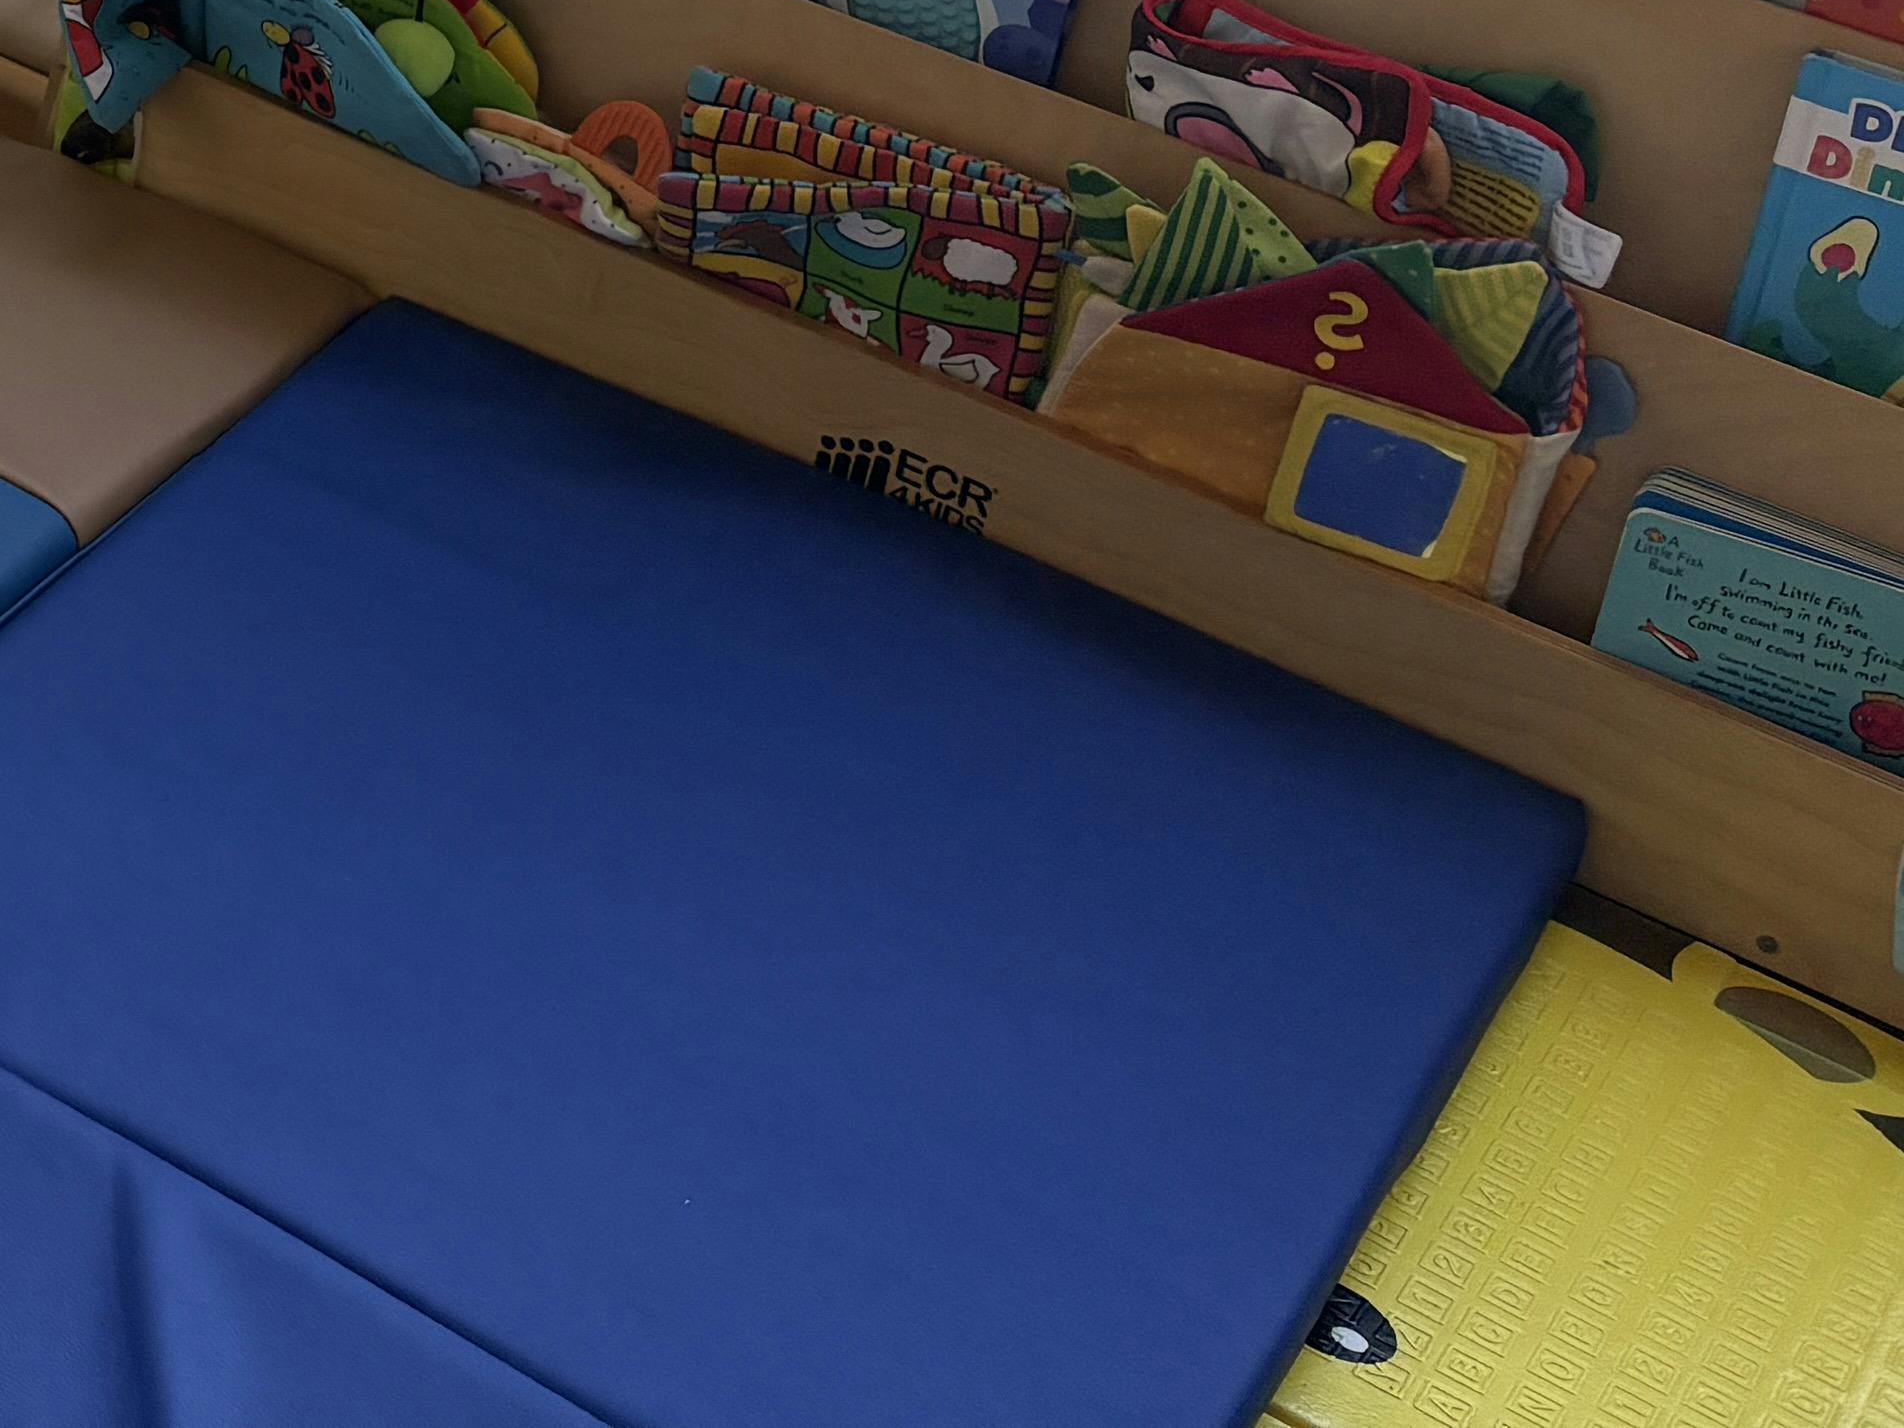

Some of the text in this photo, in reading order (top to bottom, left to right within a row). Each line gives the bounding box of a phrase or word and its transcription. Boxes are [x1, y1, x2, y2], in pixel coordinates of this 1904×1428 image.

[893, 448, 992, 519] ECR
[1633, 538, 1706, 569] Little Fish
[1667, 534, 1681, 548] A
[1647, 558, 1686, 579] Book
[1717, 584, 1795, 619] swimming
[1797, 608, 1812, 622] in
[1815, 614, 1840, 631] the
[1748, 577, 1772, 590] am
[1779, 581, 1823, 607] Little
[1664, 583, 1690, 605] I'm
[1690, 592, 1720, 616] off
[1720, 606, 1736, 620] to
[1739, 613, 1779, 633] count
[1781, 626, 1806, 645] my
[1812, 633, 1856, 659] fishy
[1686, 614, 1889, 686] Come and count with me!
